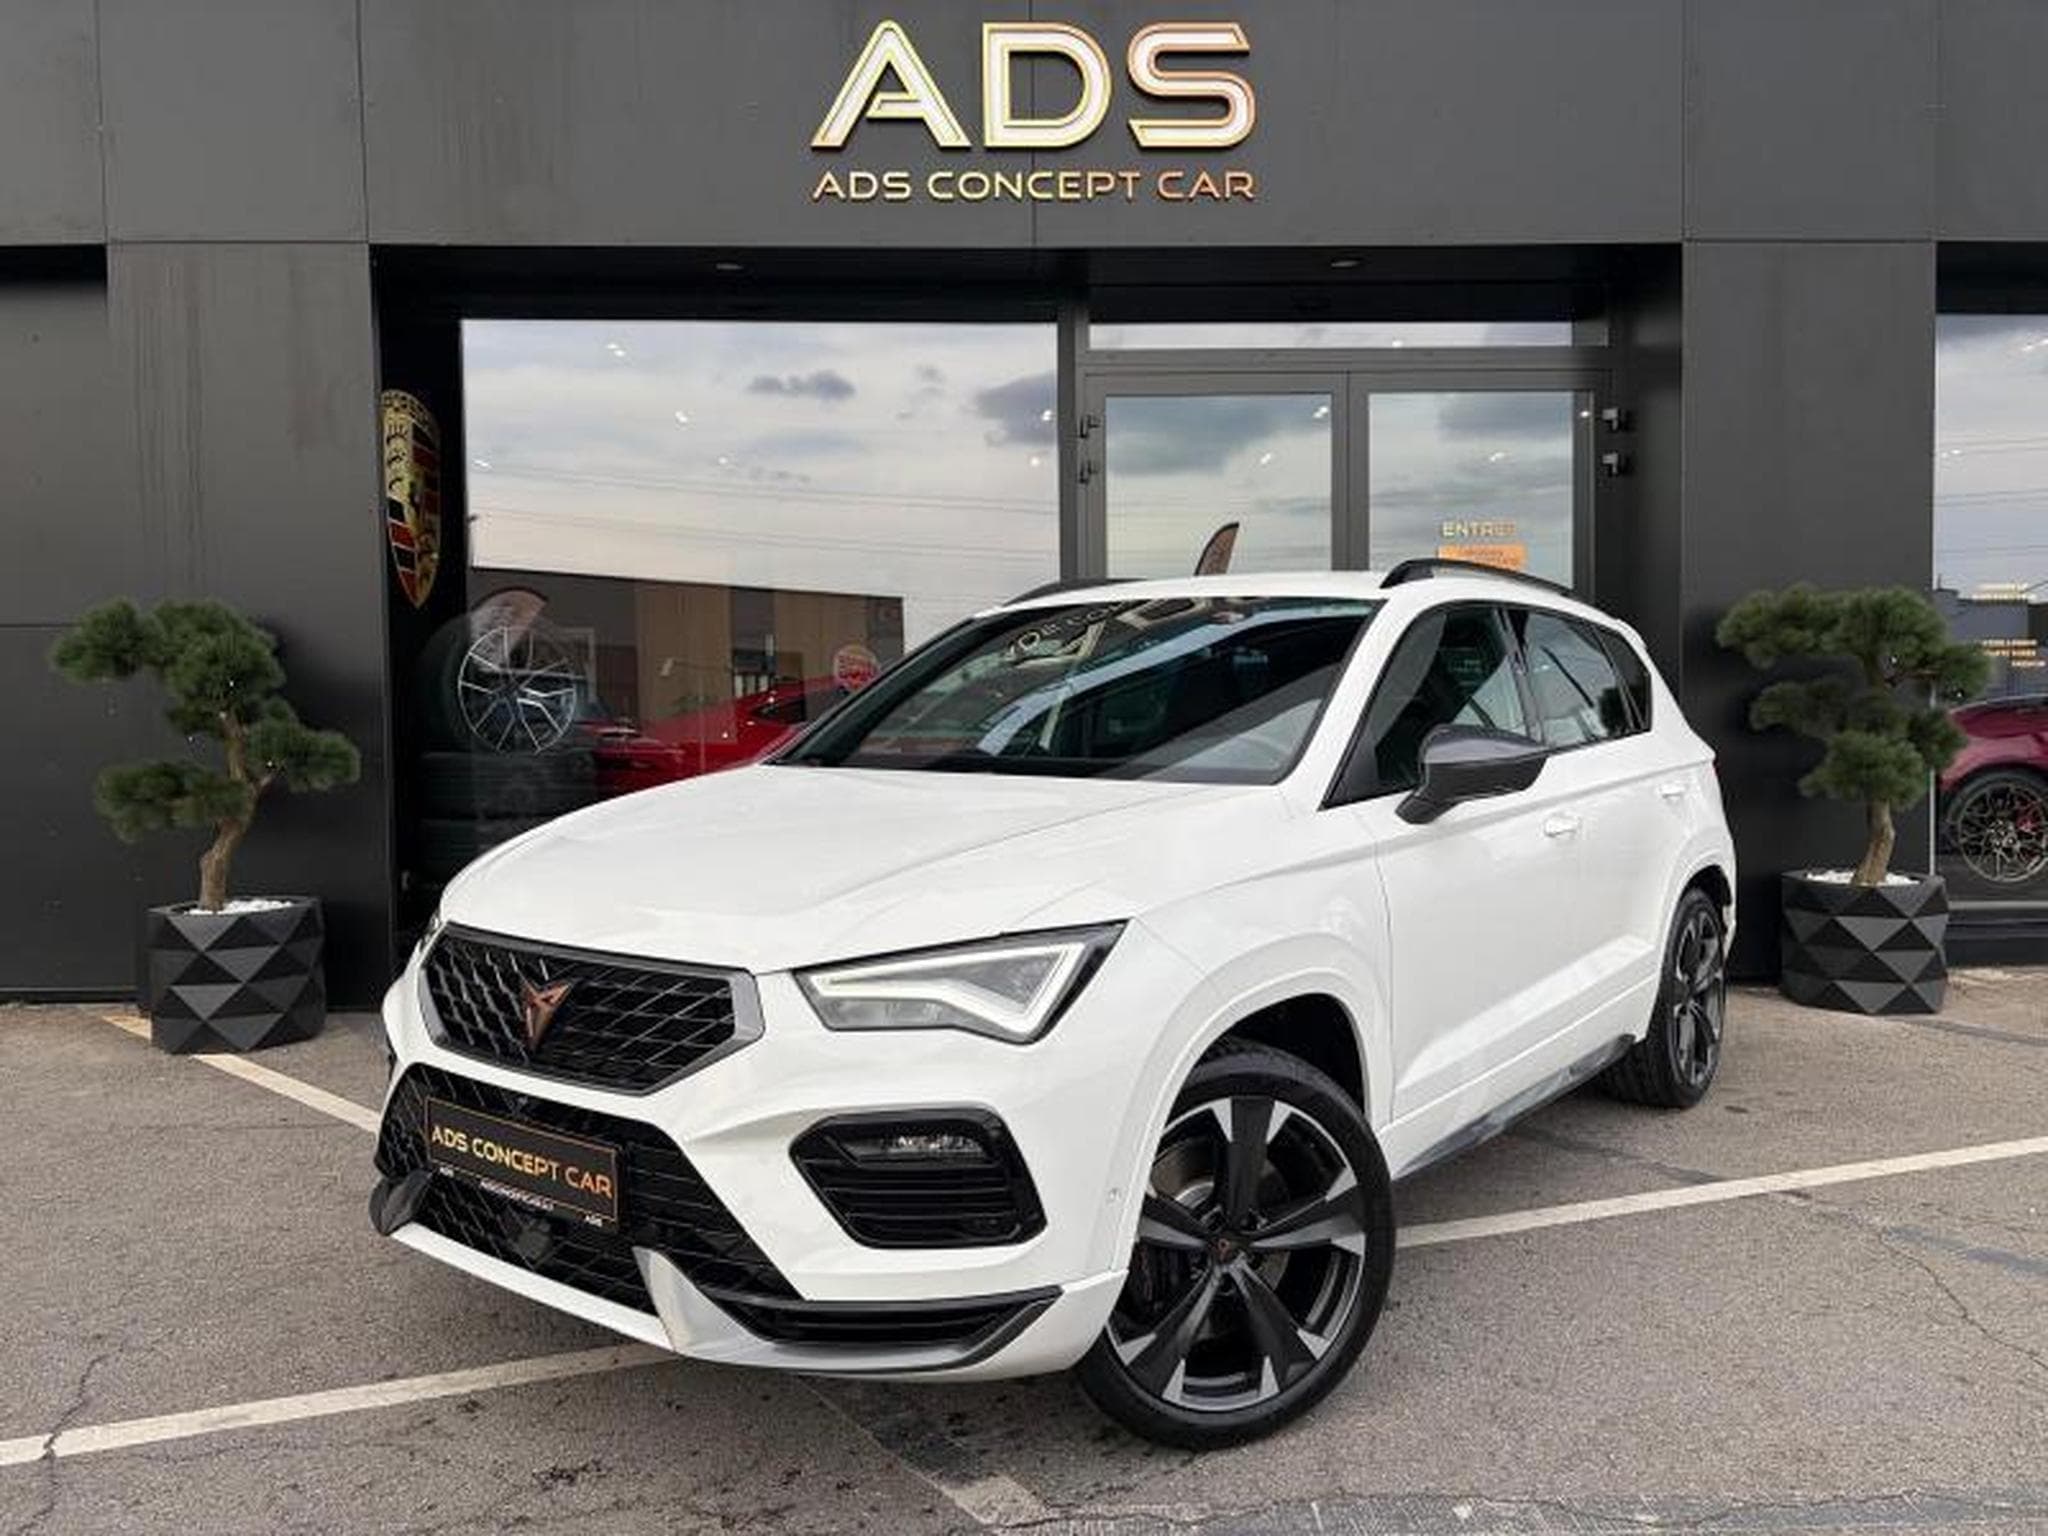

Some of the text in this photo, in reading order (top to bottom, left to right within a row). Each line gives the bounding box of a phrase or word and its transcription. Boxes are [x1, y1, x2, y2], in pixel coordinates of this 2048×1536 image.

[811, 20, 1256, 149] ADS
[813, 171, 1254, 199] ADS CONCEPT CAR
[432, 1125, 468, 1153] ADS
[472, 1138, 560, 1181] CONCEPT
[565, 1166, 613, 1199] CAR
